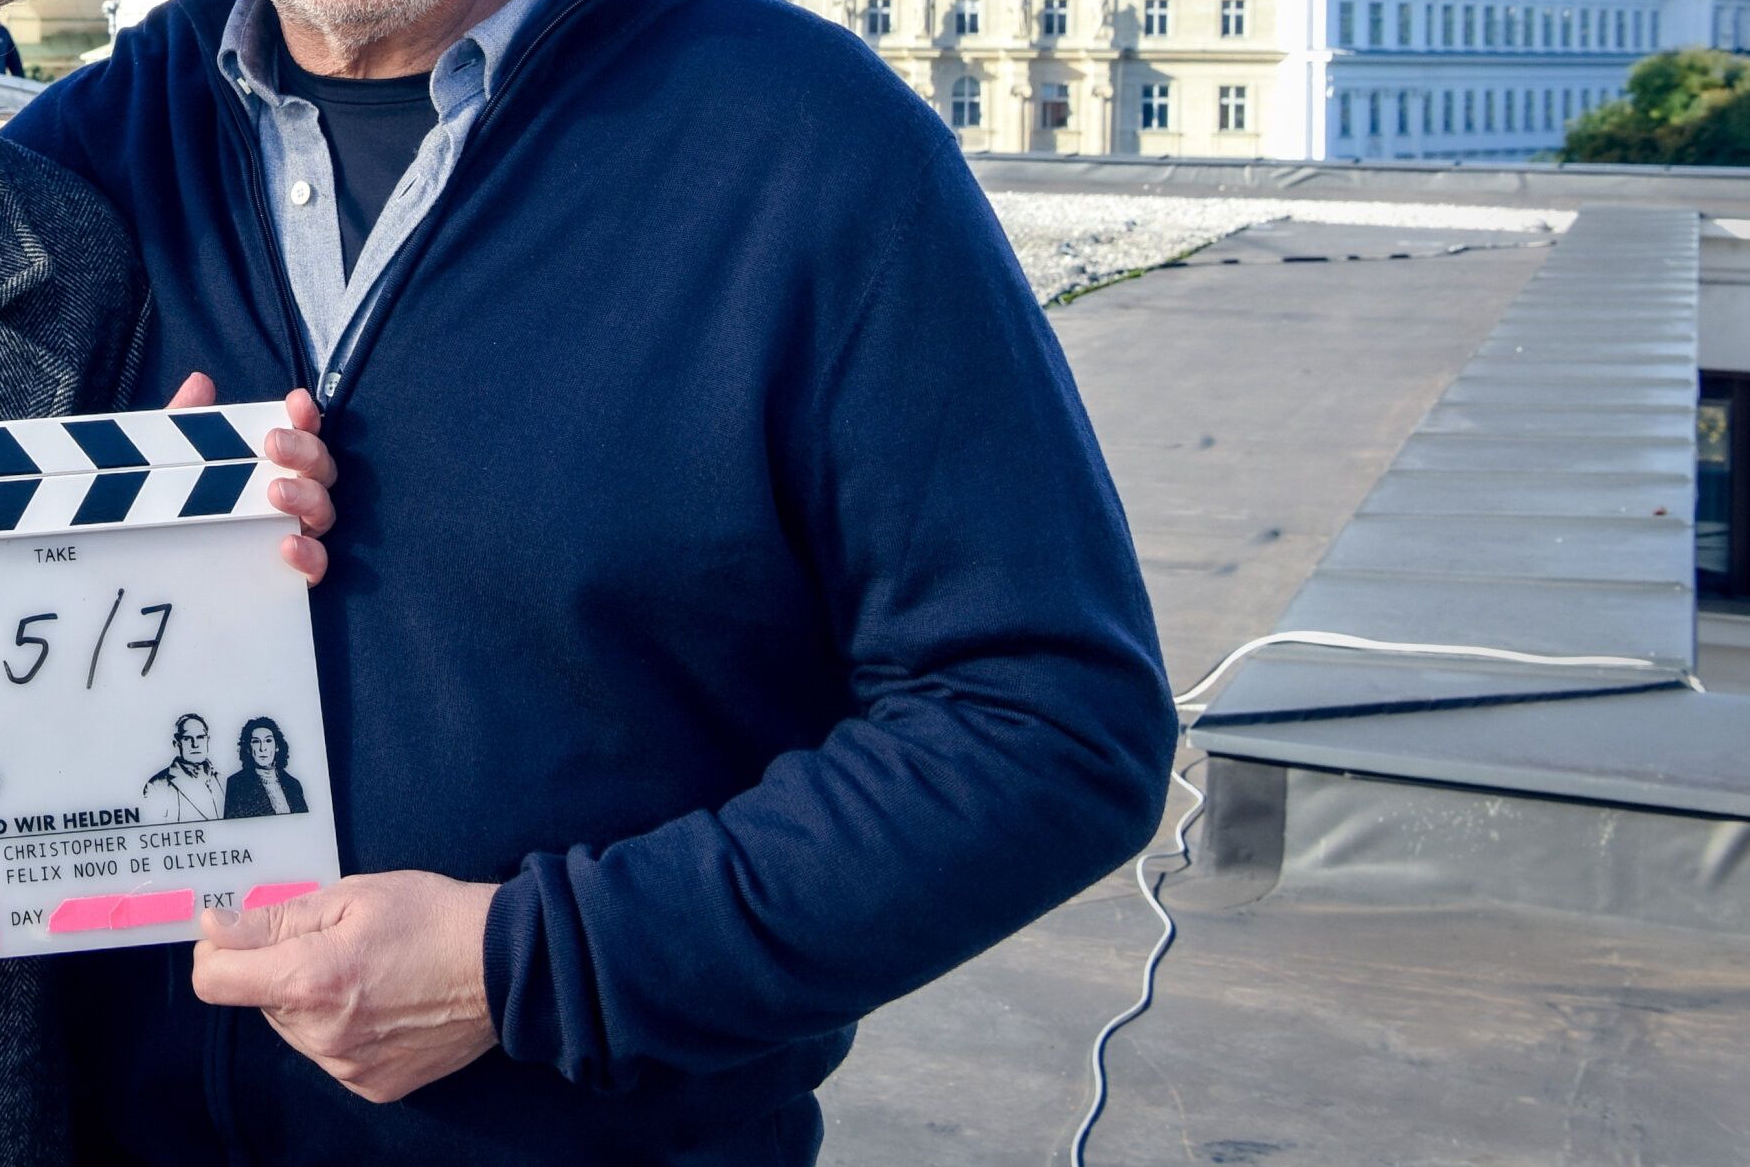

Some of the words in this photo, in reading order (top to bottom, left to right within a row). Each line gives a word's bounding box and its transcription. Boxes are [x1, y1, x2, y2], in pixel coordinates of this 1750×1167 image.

[34, 547, 77, 564] TAKE
[14, 814, 57, 834] WIR
[63, 807, 141, 830] HELDEN
[3, 836, 127, 861] CHRISTOPHER
[139, 829, 206, 850] SCHIER
[6, 865, 62, 884] FELIX
[74, 860, 118, 879] NOVO
[130, 858, 151, 874] DE
[163, 849, 253, 871] OLIVEIRA
[203, 892, 235, 909] EXT
[11, 908, 44, 927] DAY
